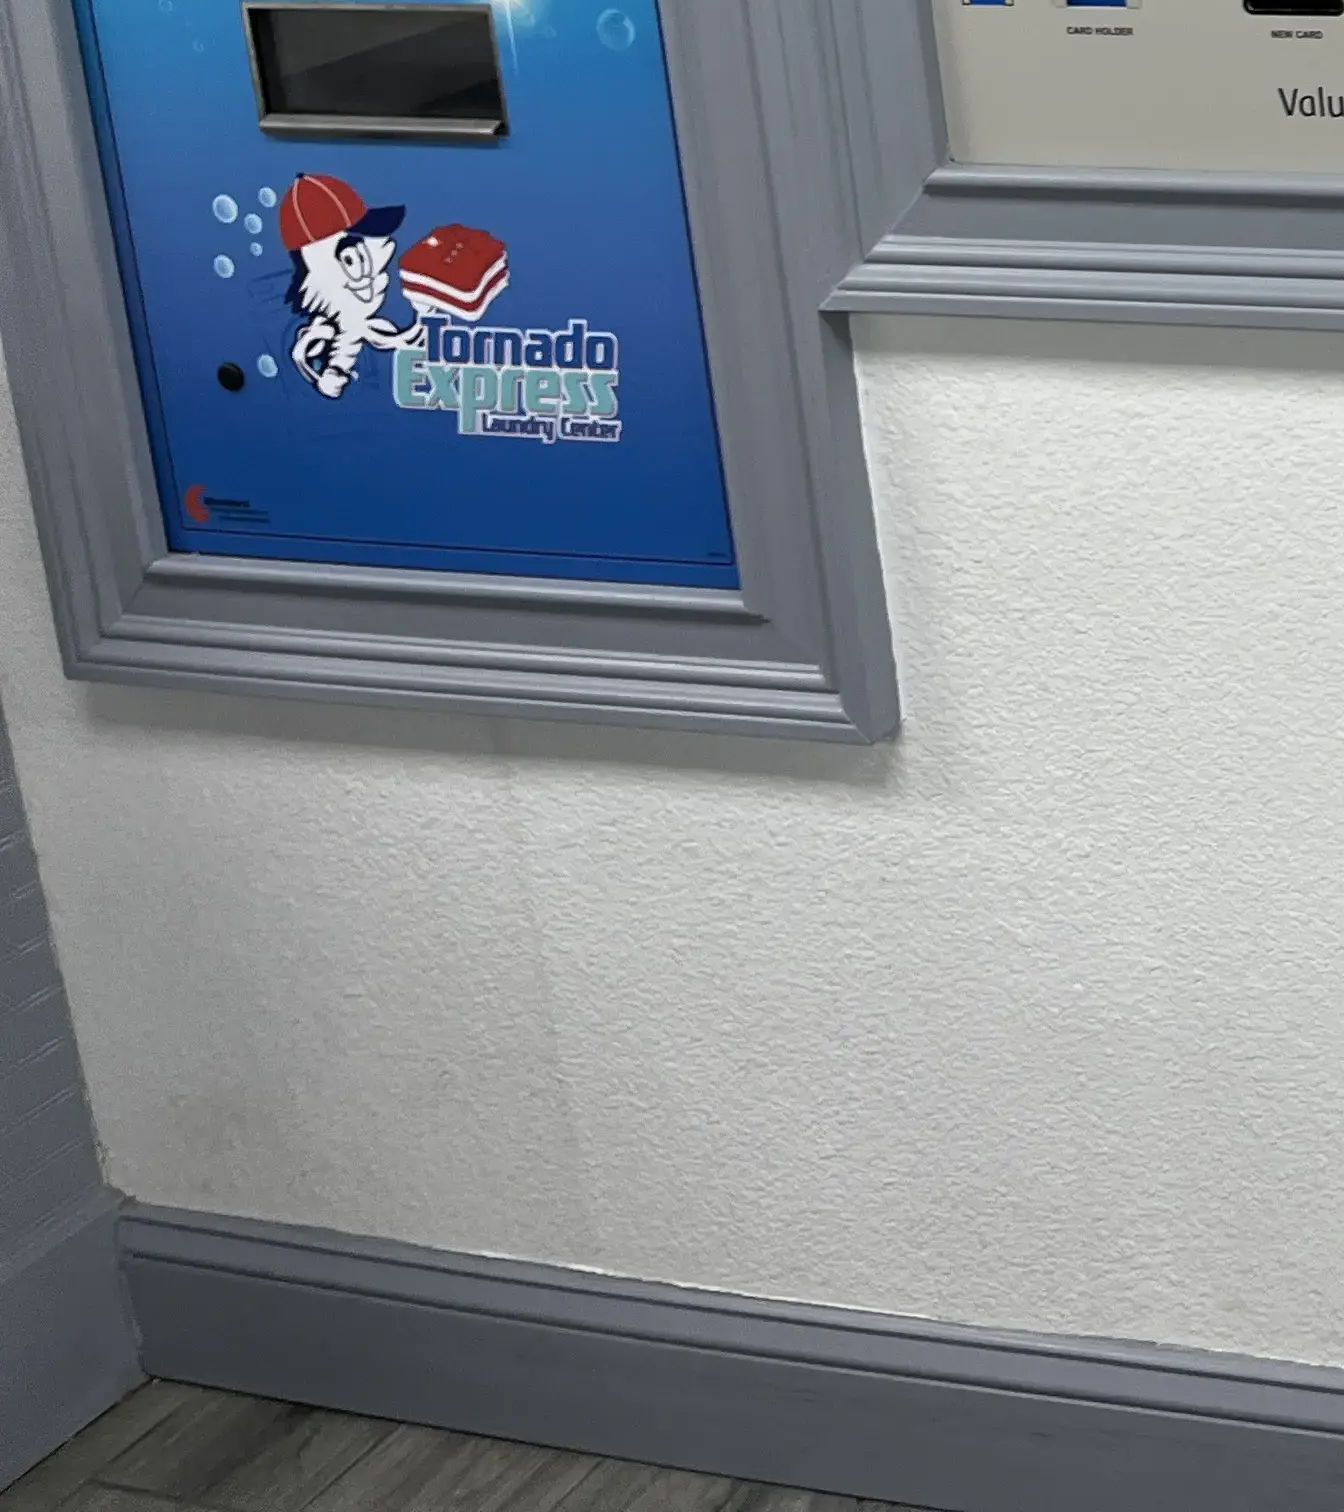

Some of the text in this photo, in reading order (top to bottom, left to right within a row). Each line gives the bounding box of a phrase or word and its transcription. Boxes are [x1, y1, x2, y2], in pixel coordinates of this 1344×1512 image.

[1067, 26, 1134, 36] CARD HOLDER
[417, 313, 618, 370] Tornado
[393, 348, 619, 435] Express
[482, 413, 621, 443] Laundry Center
